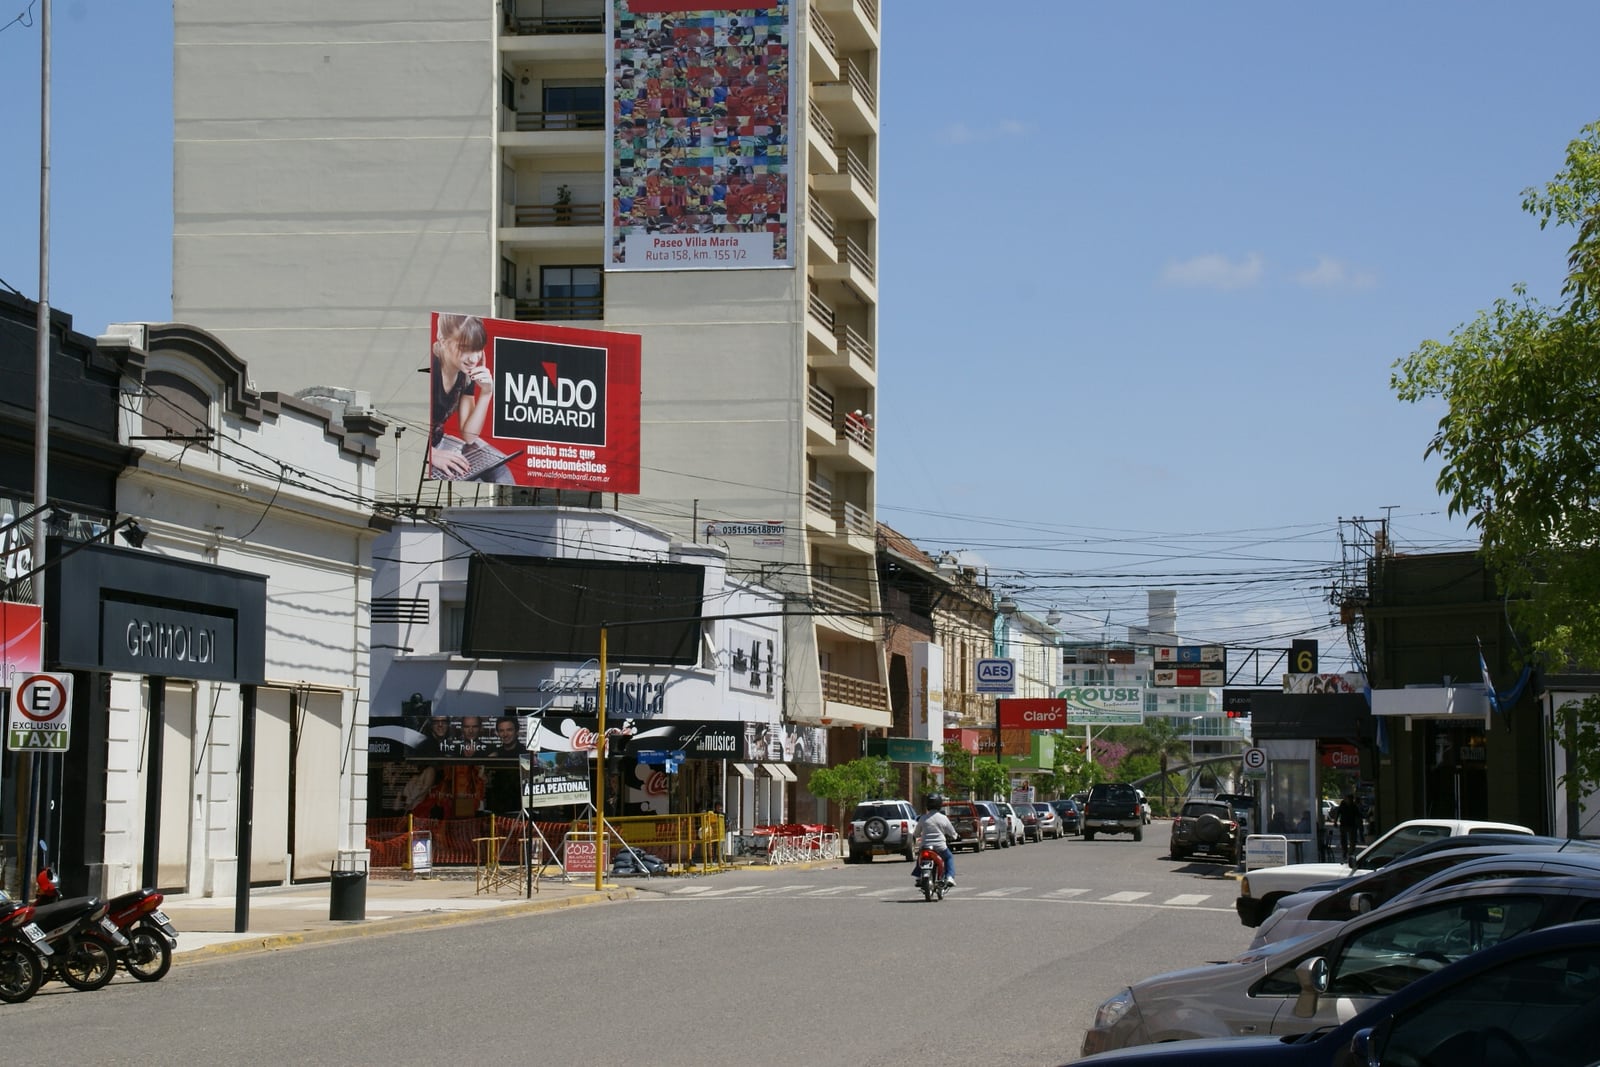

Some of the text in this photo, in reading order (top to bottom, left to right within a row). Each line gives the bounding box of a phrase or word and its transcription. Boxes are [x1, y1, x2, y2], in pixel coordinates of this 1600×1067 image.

[653, 236, 739, 248] Paseo Villa María
[645, 249, 747, 261] Ruta 158, km. 155 1/2
[504, 371, 598, 411] NALDO
[504, 403, 596, 429] LOMBARDI
[527, 444, 596, 461] mucho más que
[527, 456, 607, 474] electrodomésticos
[126, 618, 216, 665] GRIMOLDI
[1297, 650, 1313, 672] 6
[982, 665, 1009, 677] AES
[32, 685, 52, 711] E
[1058, 686, 1140, 702] HOUSE
[1023, 710, 1056, 722] Claro
[12, 721, 68, 731] EXCLUSIVO
[15, 730, 62, 749] TAXI
[439, 739, 455, 751] the
[459, 739, 487, 755] police
[704, 730, 736, 751] música
[1251, 753, 1259, 764] E
[1331, 751, 1360, 765] Claro
[547, 780, 589, 794] PEATONAL
